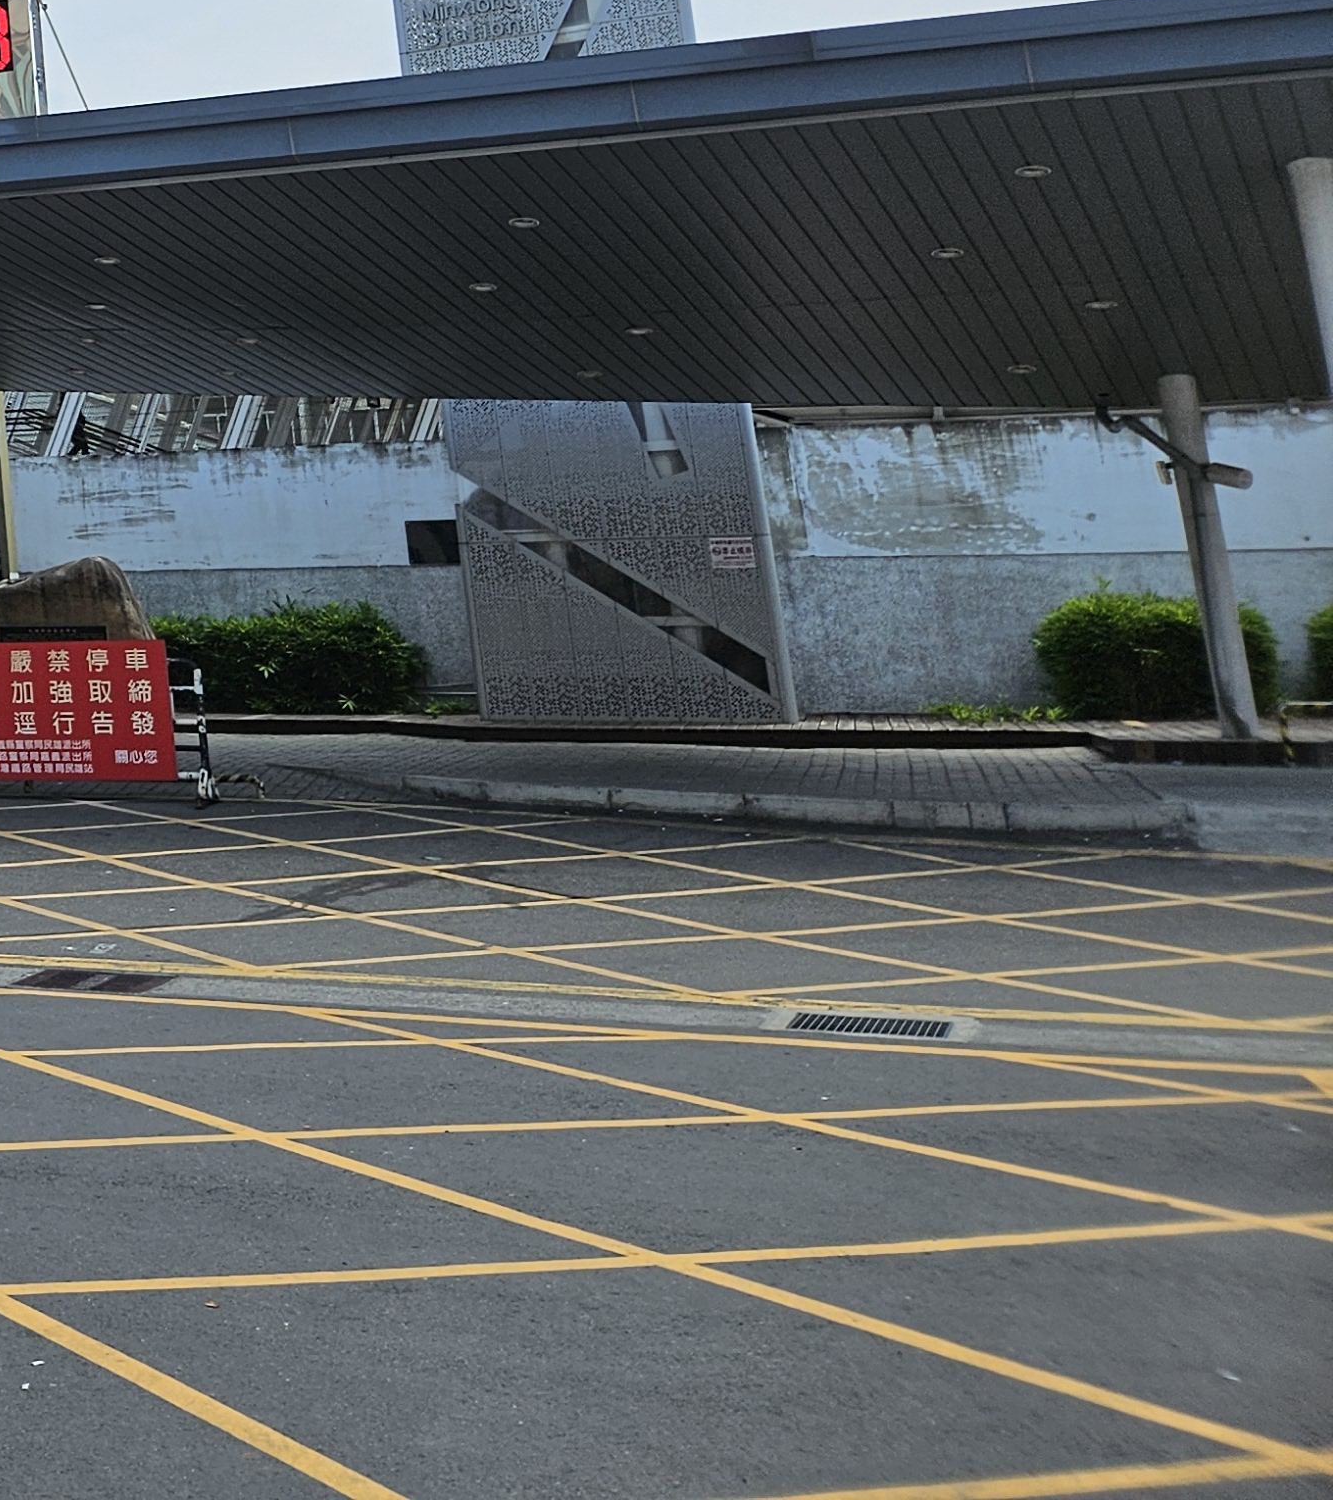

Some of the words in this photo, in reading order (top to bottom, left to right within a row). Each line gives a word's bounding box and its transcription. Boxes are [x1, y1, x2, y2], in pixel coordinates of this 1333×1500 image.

[9, 648, 149, 673] 嚴禁停車
[10, 679, 153, 704] 加強取締
[13, 710, 156, 735] 逕行告發
[114, 749, 159, 765] 關心您
